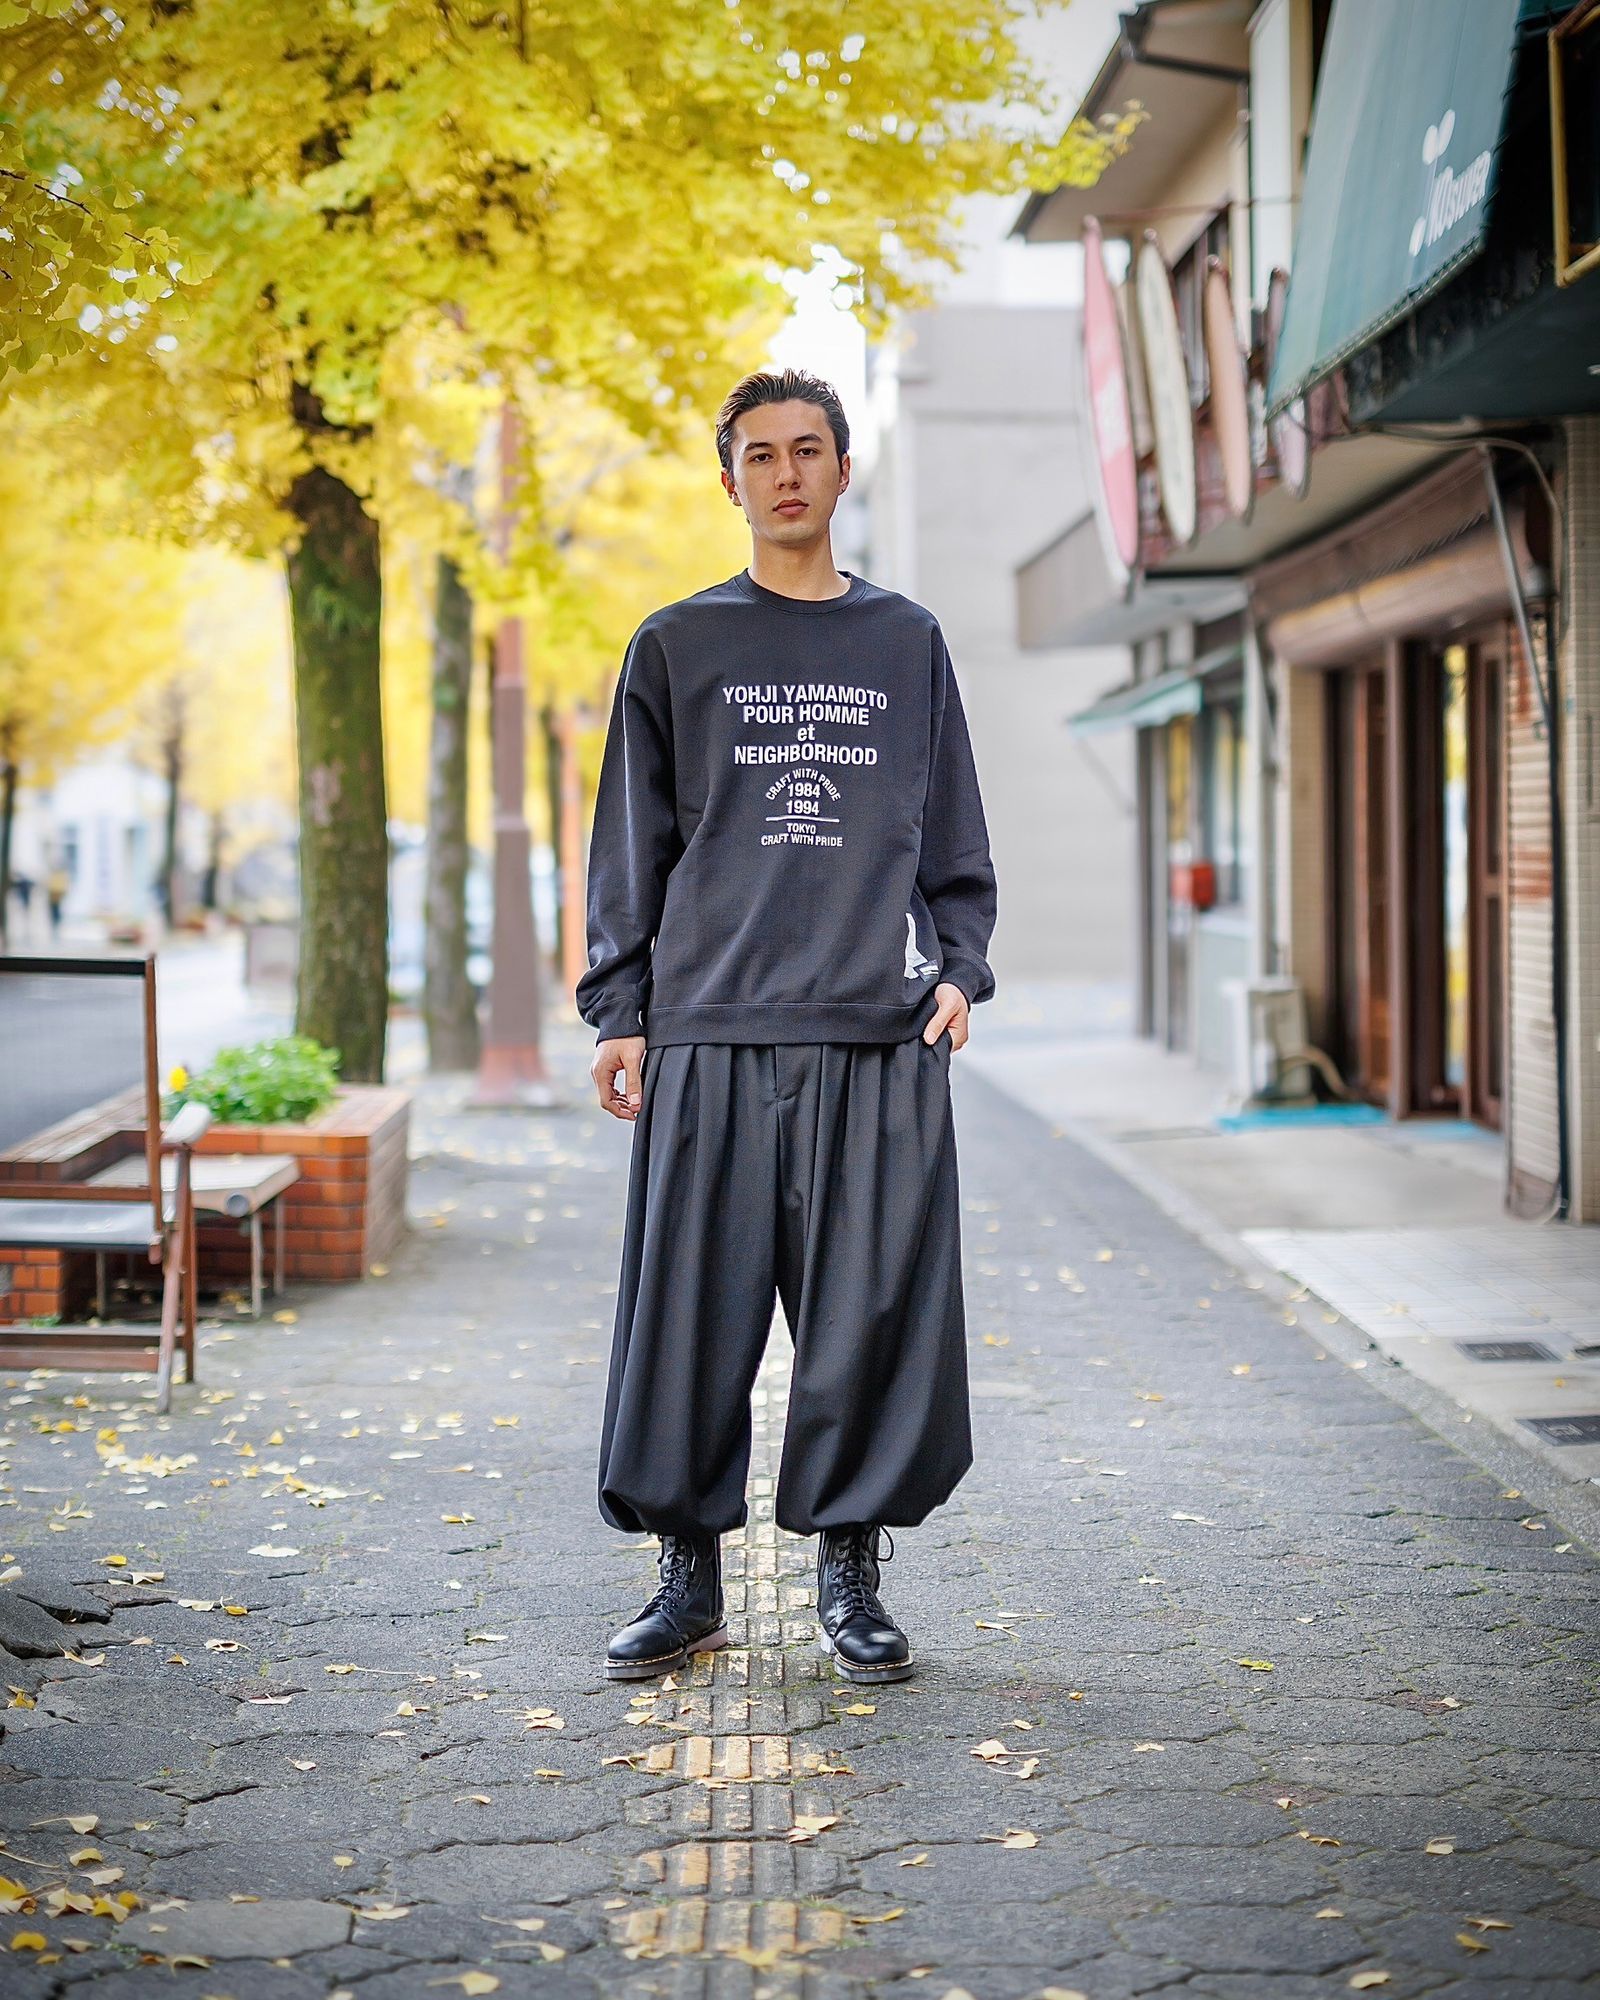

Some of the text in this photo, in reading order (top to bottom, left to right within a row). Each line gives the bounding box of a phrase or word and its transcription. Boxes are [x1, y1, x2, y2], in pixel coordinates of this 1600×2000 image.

[723, 684, 887, 709] YOHJI YAMAMOTO
[744, 704, 869, 725] POUR HOMME
[798, 724, 815, 741] et
[735, 743, 877, 765] NEIGHBORHOOD
[766, 768, 840, 801] CRAFT WITH PRIDE
[788, 783, 820, 798] 1984
[786, 800, 819, 815] 1994
[787, 823, 816, 833] TOKYO
[761, 833, 842, 846] CRAFT WITH PRIDE
